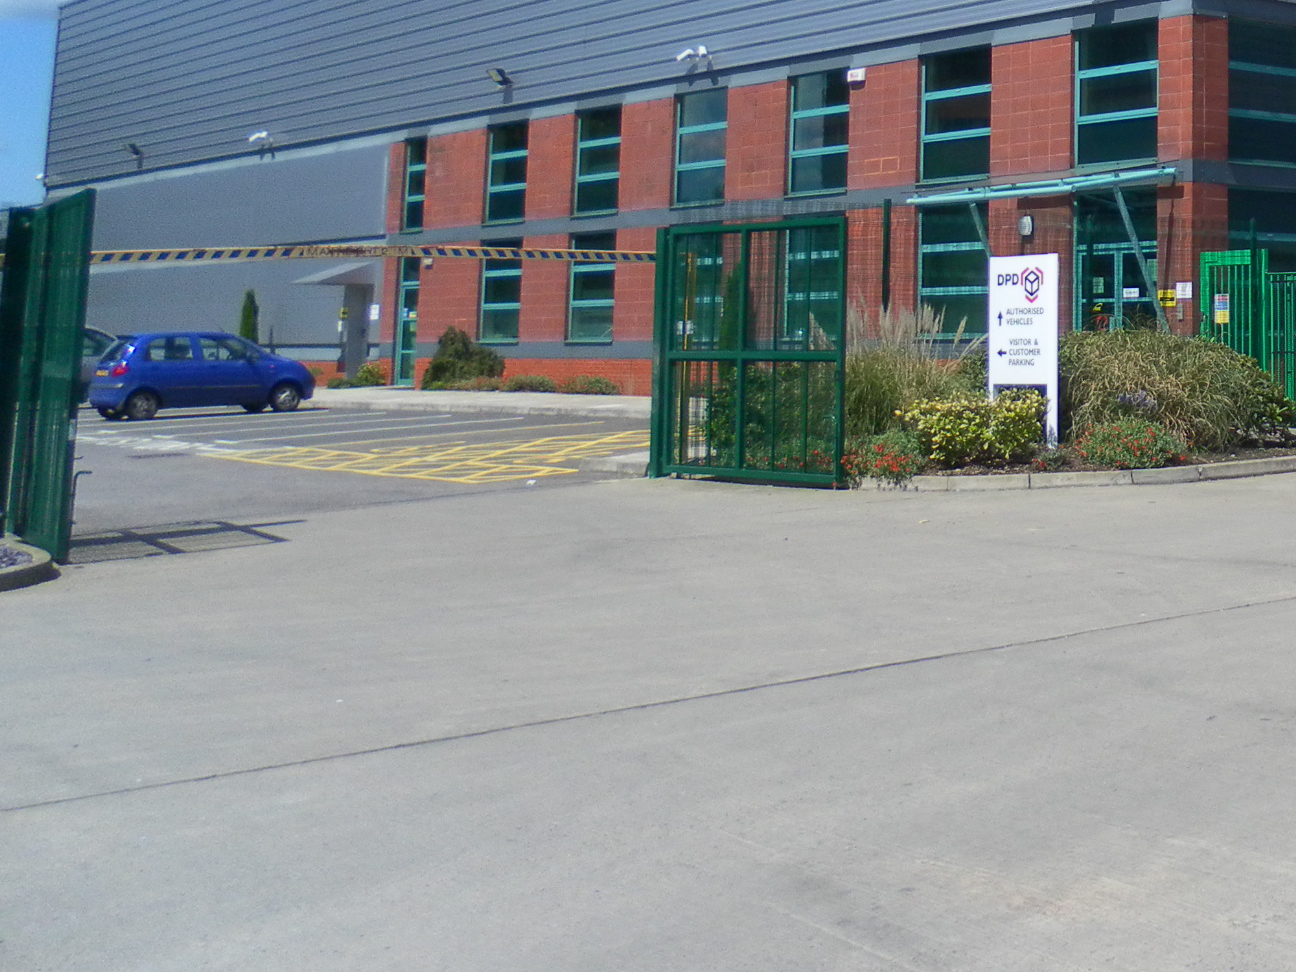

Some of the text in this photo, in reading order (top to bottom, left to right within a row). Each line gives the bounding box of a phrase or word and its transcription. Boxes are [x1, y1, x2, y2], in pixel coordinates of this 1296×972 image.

[997, 273, 1019, 286] DPD
[1006, 307, 1044, 315] AUTHORISED
[1006, 317, 1033, 325] VEHICLES
[1009, 338, 1031, 346] VISITOR
[1008, 348, 1041, 356] CUSTOMER
[1008, 358, 1035, 366] PARKING
